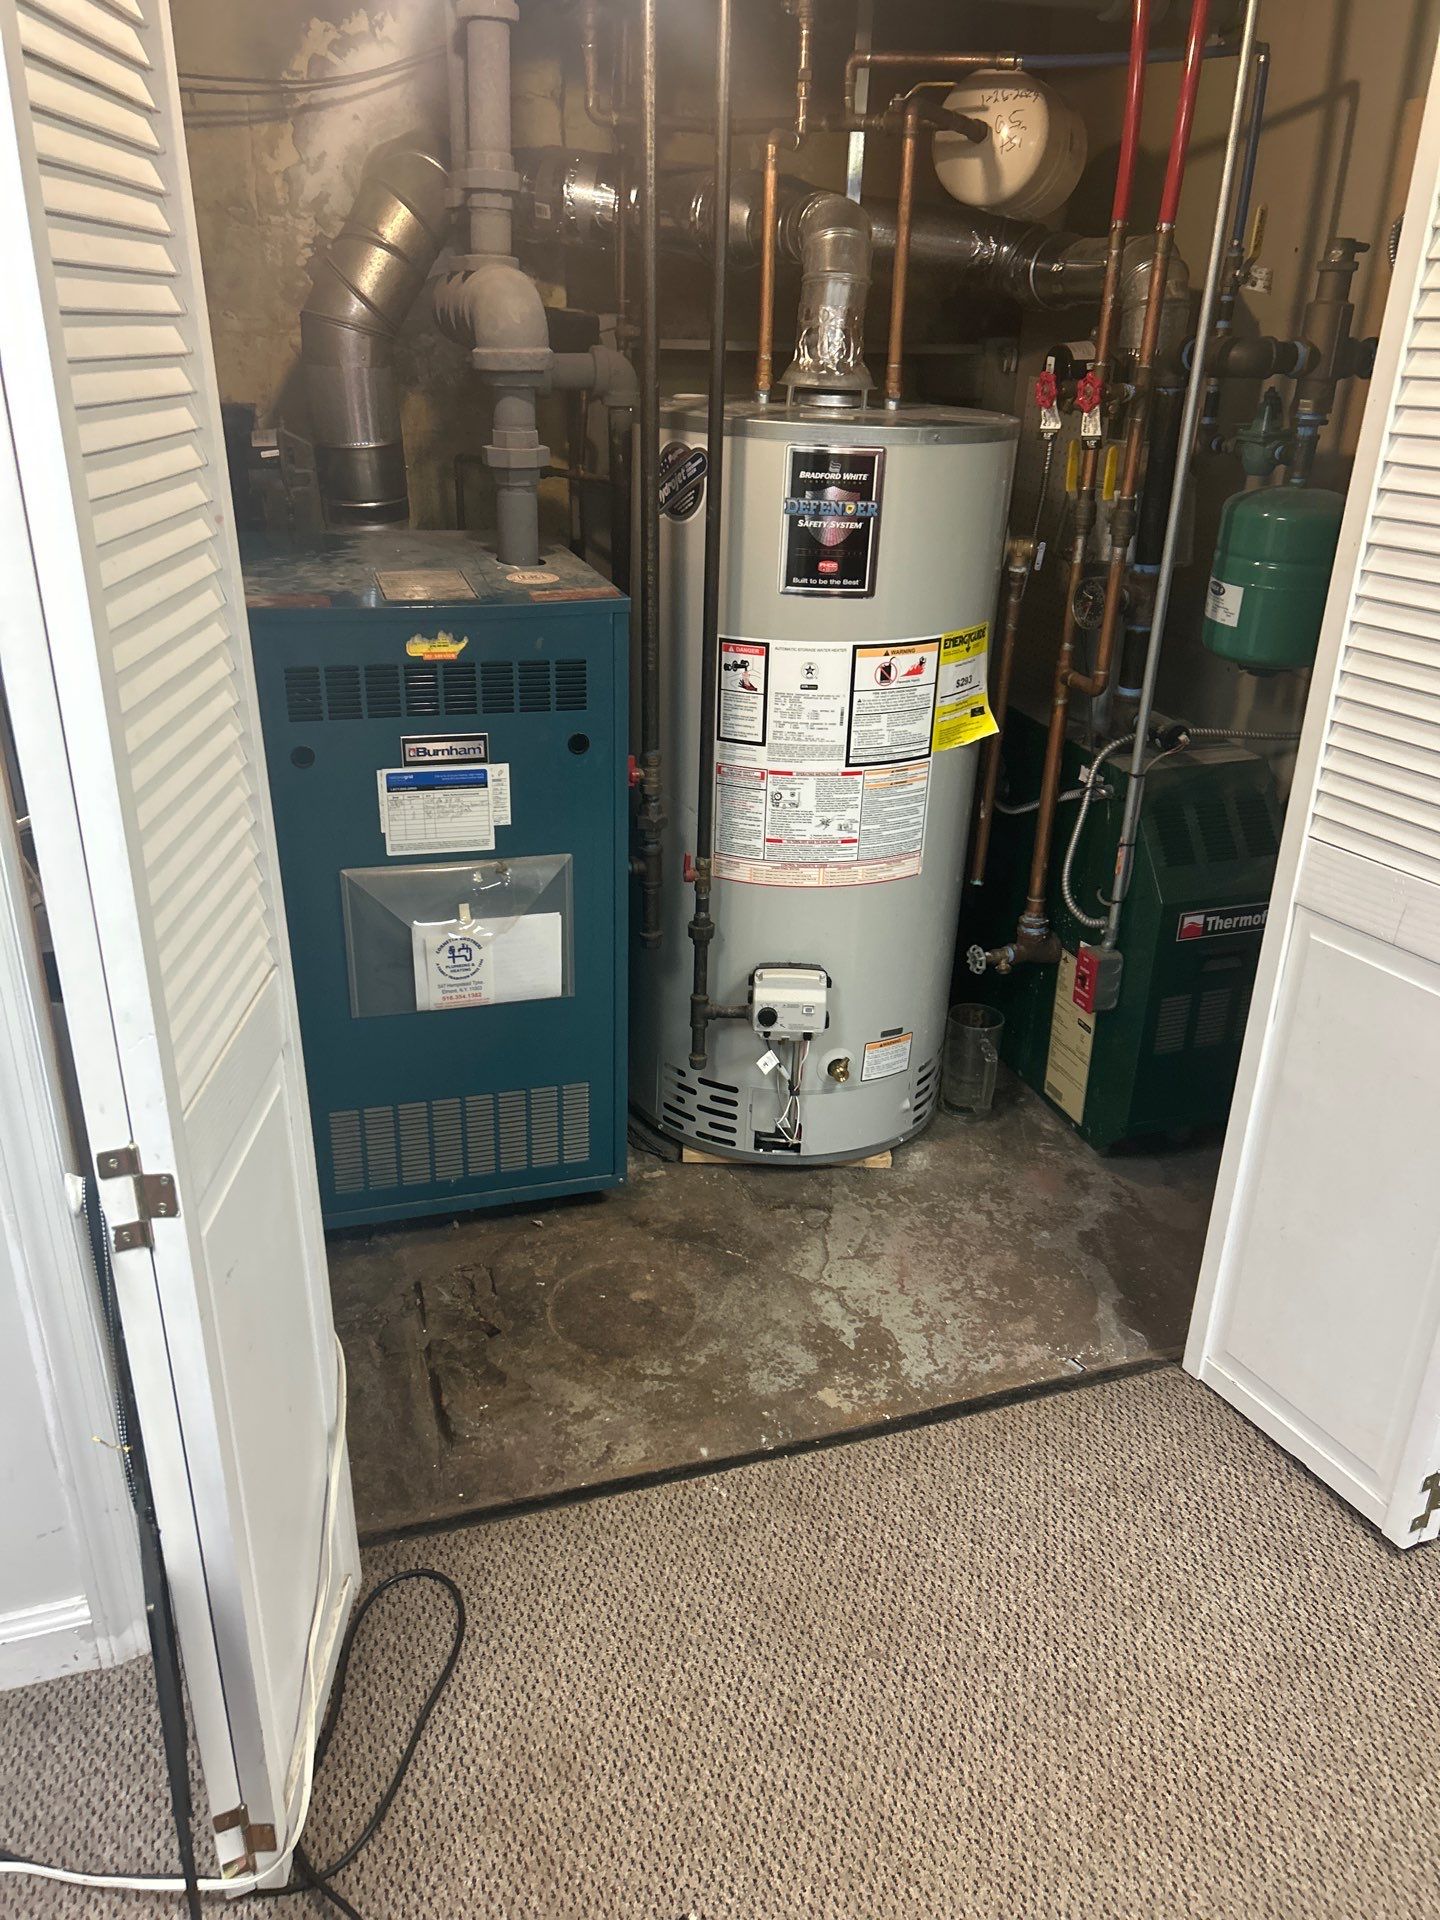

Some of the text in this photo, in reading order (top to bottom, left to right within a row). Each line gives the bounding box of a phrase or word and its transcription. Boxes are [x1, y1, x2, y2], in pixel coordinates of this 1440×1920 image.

[799, 471, 869, 481] BRADFORD WHITE
[784, 497, 878, 517] DEFENDER
[797, 519, 863, 529] SAFETY SYSTEM
[736, 646, 760, 654] DANGER
[955, 675, 972, 688] $293
[416, 745, 482, 757] Burnham
